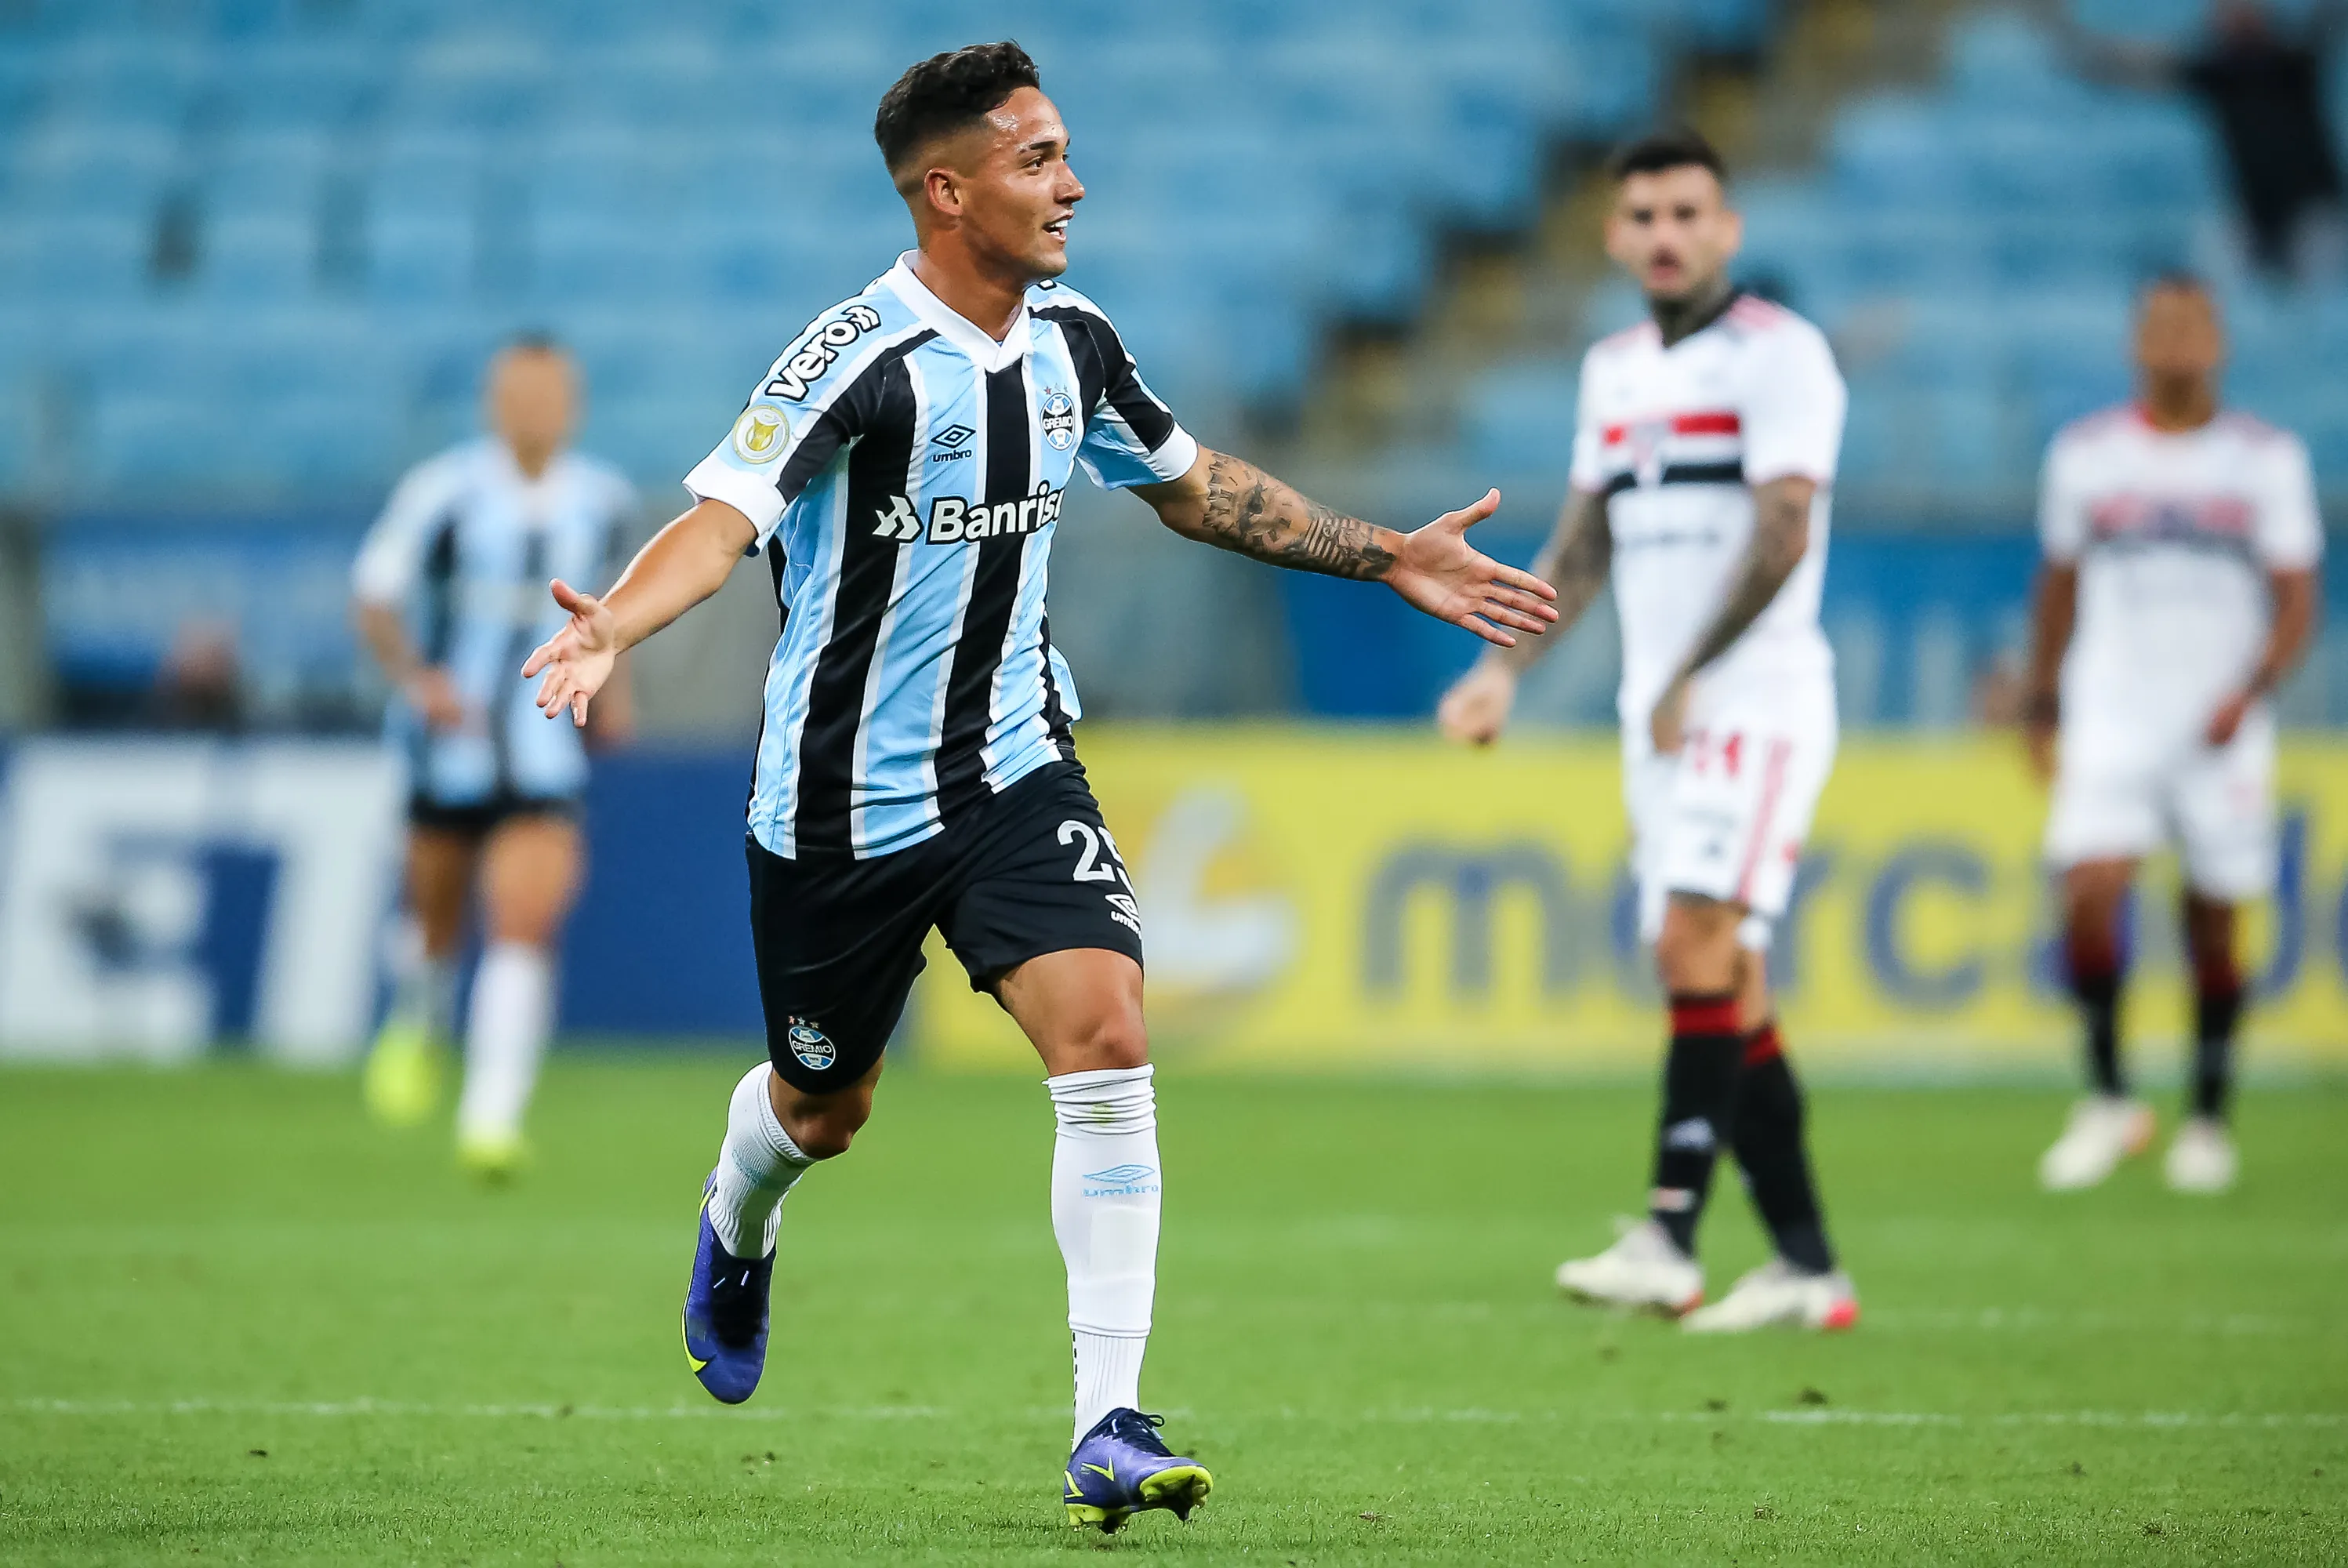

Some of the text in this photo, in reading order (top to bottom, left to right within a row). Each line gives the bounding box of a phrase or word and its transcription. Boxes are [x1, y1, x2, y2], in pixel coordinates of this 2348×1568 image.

[765, 320, 859, 401] vero
[933, 449, 972, 463] umbro
[1083, 1184, 1159, 1196] umbro
